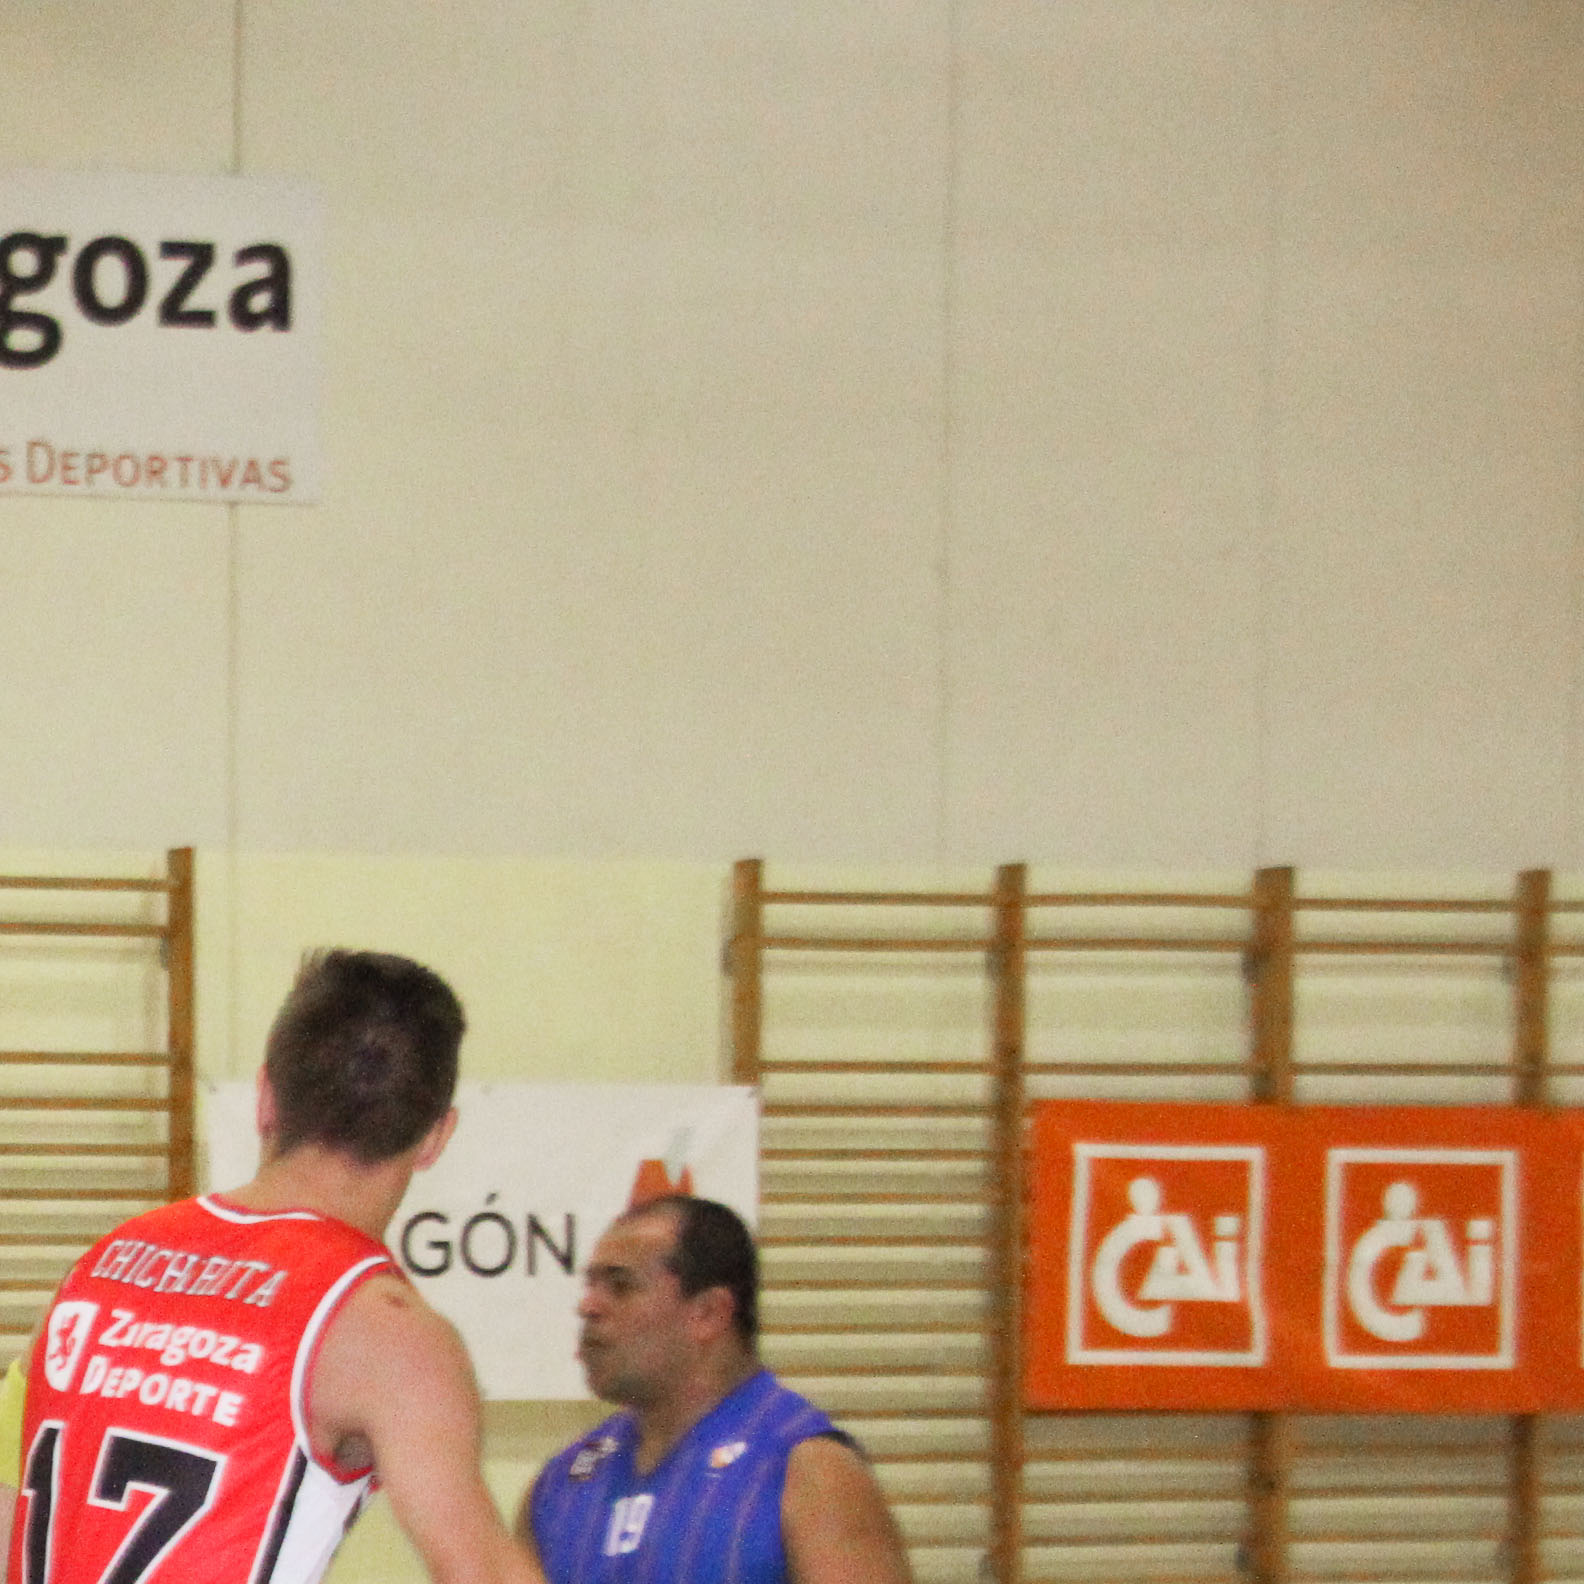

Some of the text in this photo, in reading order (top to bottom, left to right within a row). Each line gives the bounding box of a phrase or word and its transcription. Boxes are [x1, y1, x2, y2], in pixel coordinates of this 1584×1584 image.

[26, 440, 293, 495] DEPORTIVAS
[399, 1191, 576, 1279] GÓN
[79, 1354, 246, 1427] DEPORTE
